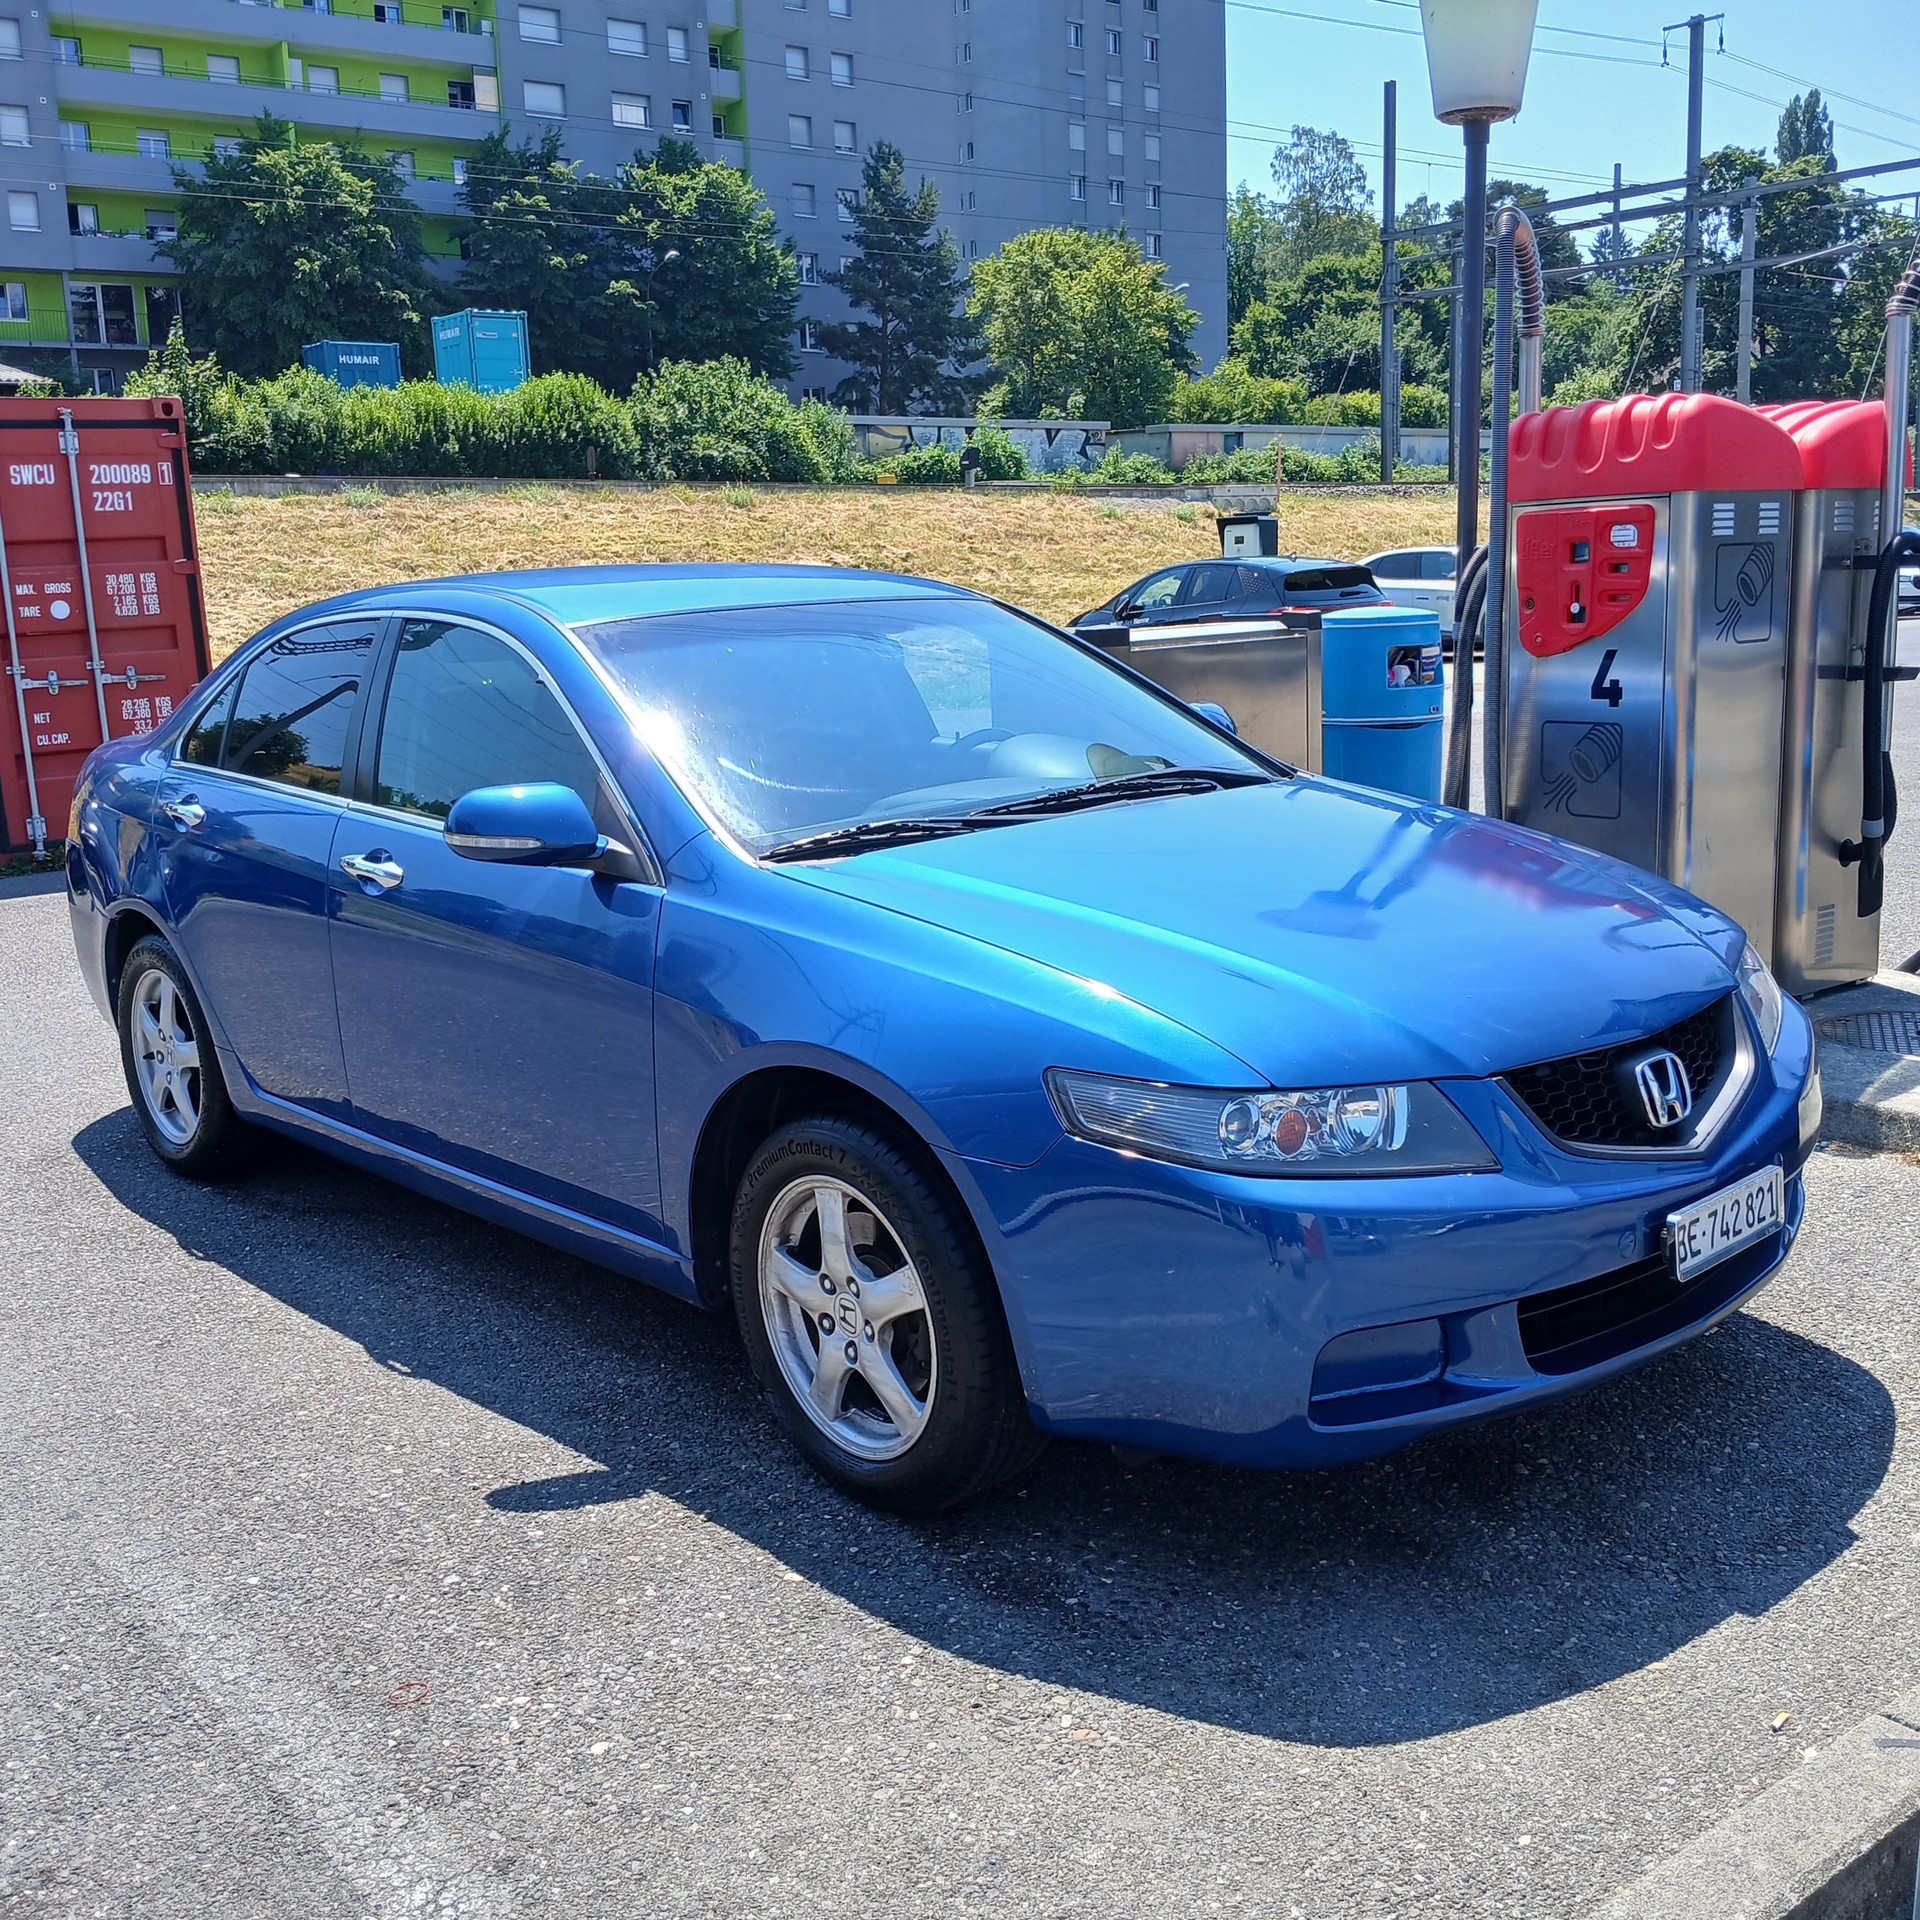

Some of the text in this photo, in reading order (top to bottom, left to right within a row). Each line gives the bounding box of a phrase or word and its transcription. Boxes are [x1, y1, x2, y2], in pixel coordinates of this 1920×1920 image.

[439, 326, 461, 340] HUMAIR
[338, 354, 381, 365] HUMAIR
[9, 463, 171, 485] SWCU 200089 1
[92, 491, 134, 511] 22G1
[105, 572, 156, 585] 30.480 KGS
[15, 582, 72, 595] MAX. GROSS
[106, 582, 158, 595] 67.200 LBS
[113, 594, 159, 606] 2.185 KGS
[18, 606, 42, 618] TARE
[115, 604, 161, 616] 4.820 LBS
[1591, 648, 1623, 708] 4
[121, 696, 172, 710] 28.295 KGS
[33, 712, 51, 724] NET
[122, 708, 151, 720] 62.380
[134, 719, 153, 730] 33.2
[746, 1139, 847, 1188] PremiumContact 7
